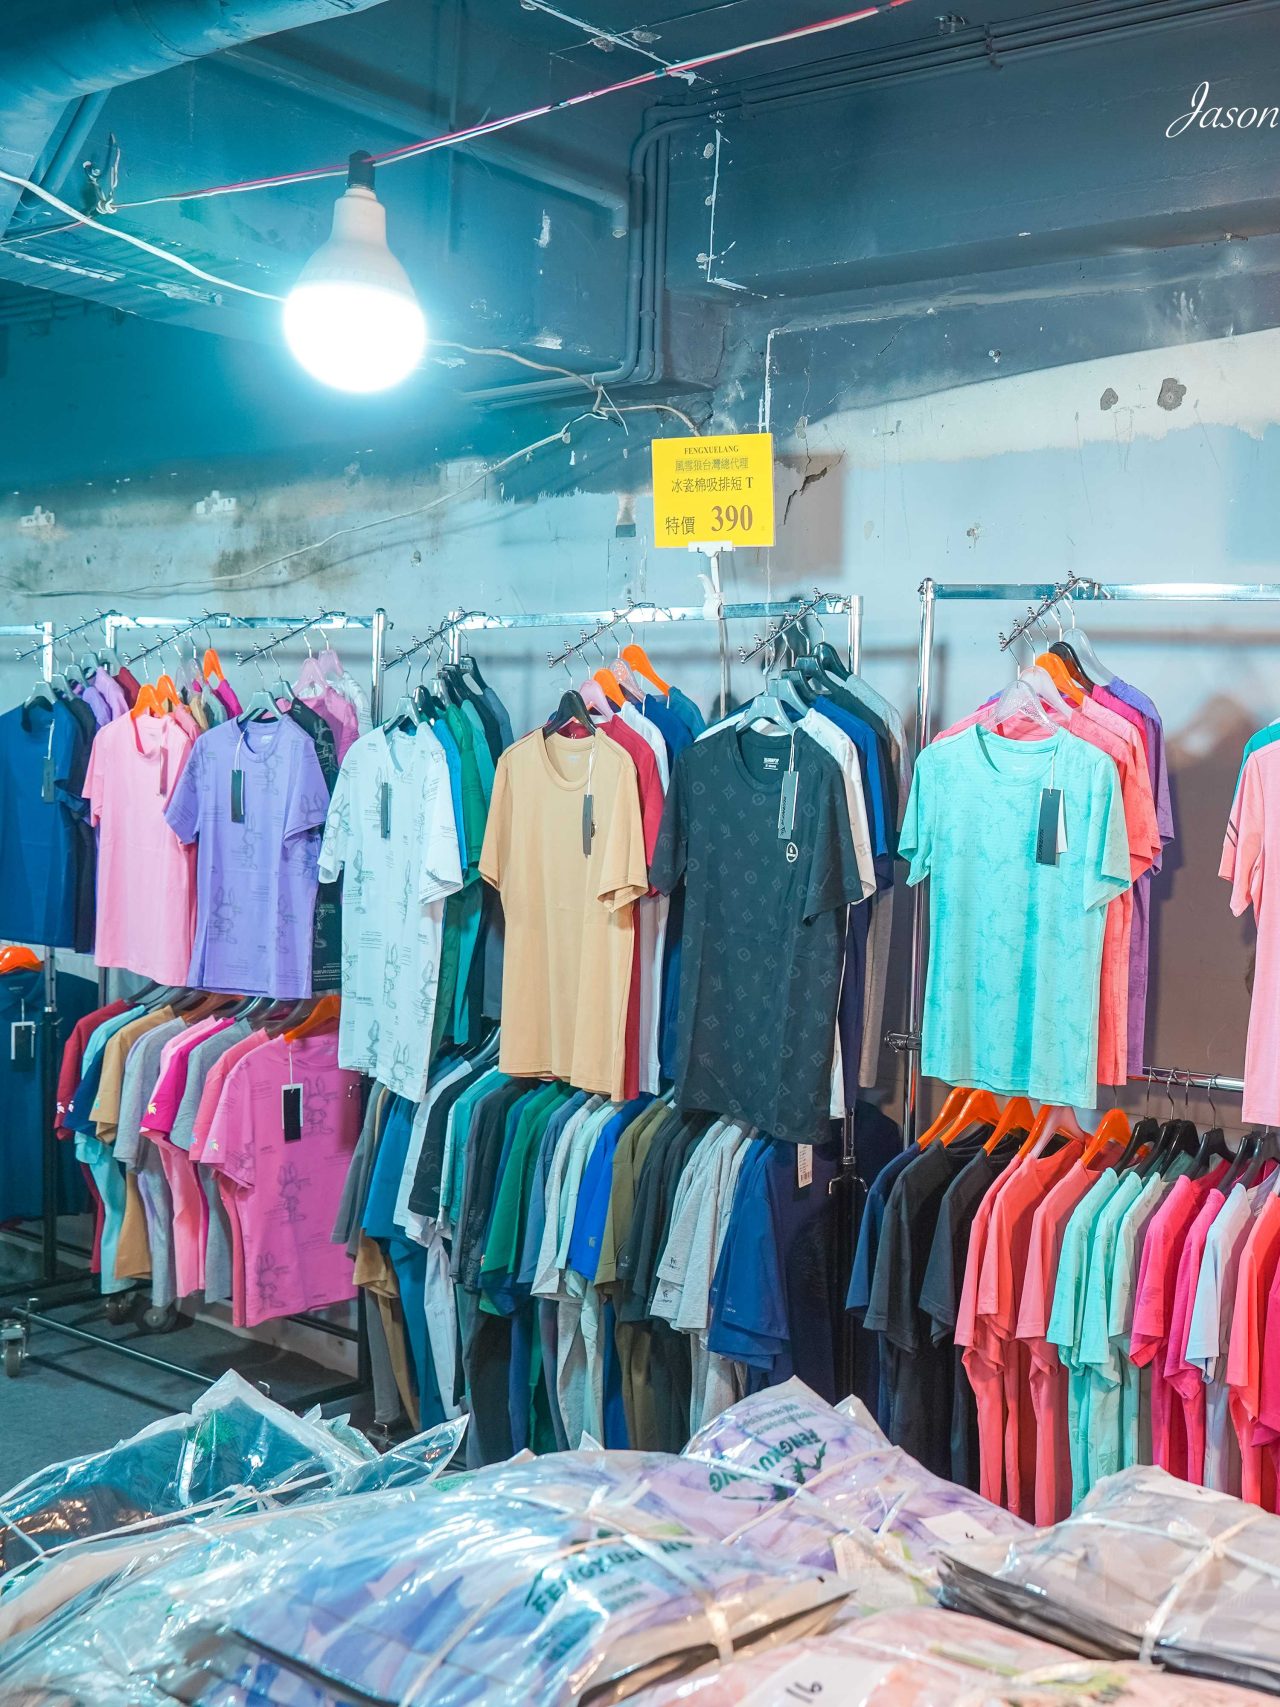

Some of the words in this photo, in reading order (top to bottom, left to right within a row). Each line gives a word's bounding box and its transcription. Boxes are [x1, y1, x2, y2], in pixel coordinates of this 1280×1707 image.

[684, 445, 739, 455] FENGXUELANG
[745, 476, 754, 489] T
[665, 516, 696, 535] 特價
[711, 504, 753, 532] 390
